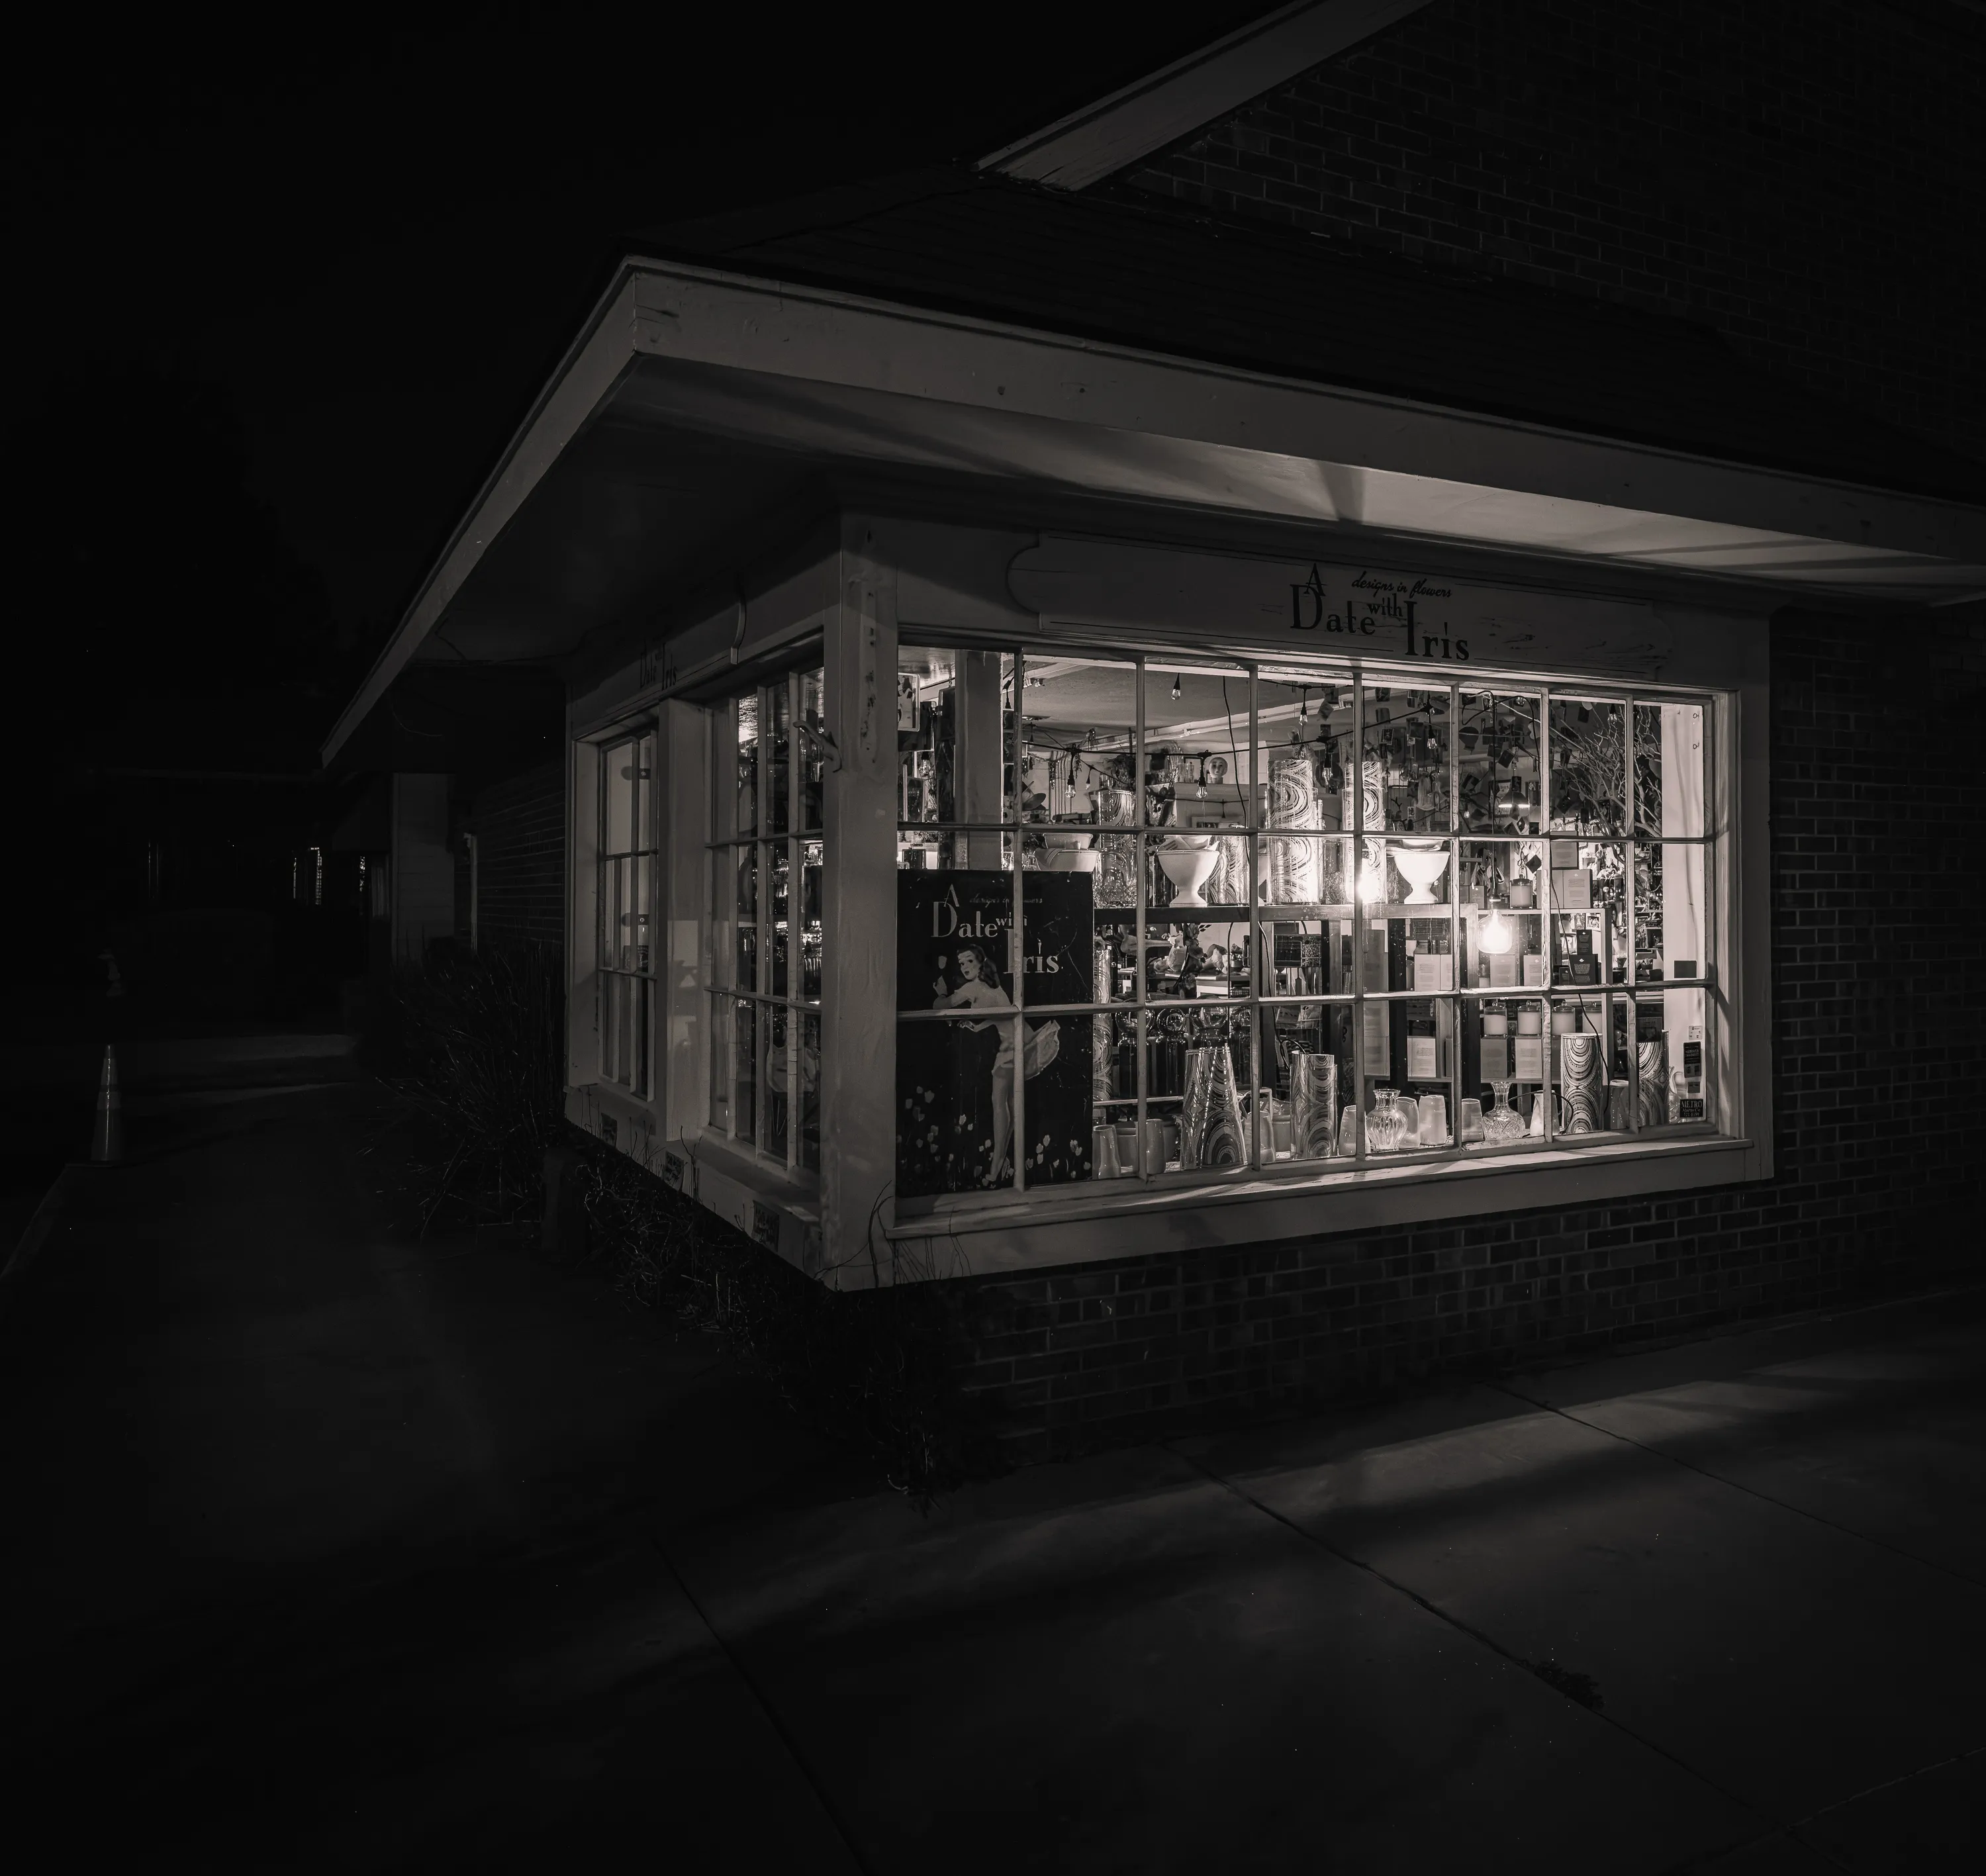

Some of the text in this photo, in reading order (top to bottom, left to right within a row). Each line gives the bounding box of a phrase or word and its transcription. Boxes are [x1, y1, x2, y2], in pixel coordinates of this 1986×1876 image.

[1303, 563, 1327, 597] A
[1352, 571, 1452, 598] designs in flowers
[1290, 584, 1470, 661] Date with Iris
[661, 642, 679, 691] Iris
[943, 884, 959, 908] A
[930, 901, 998, 937] Date
